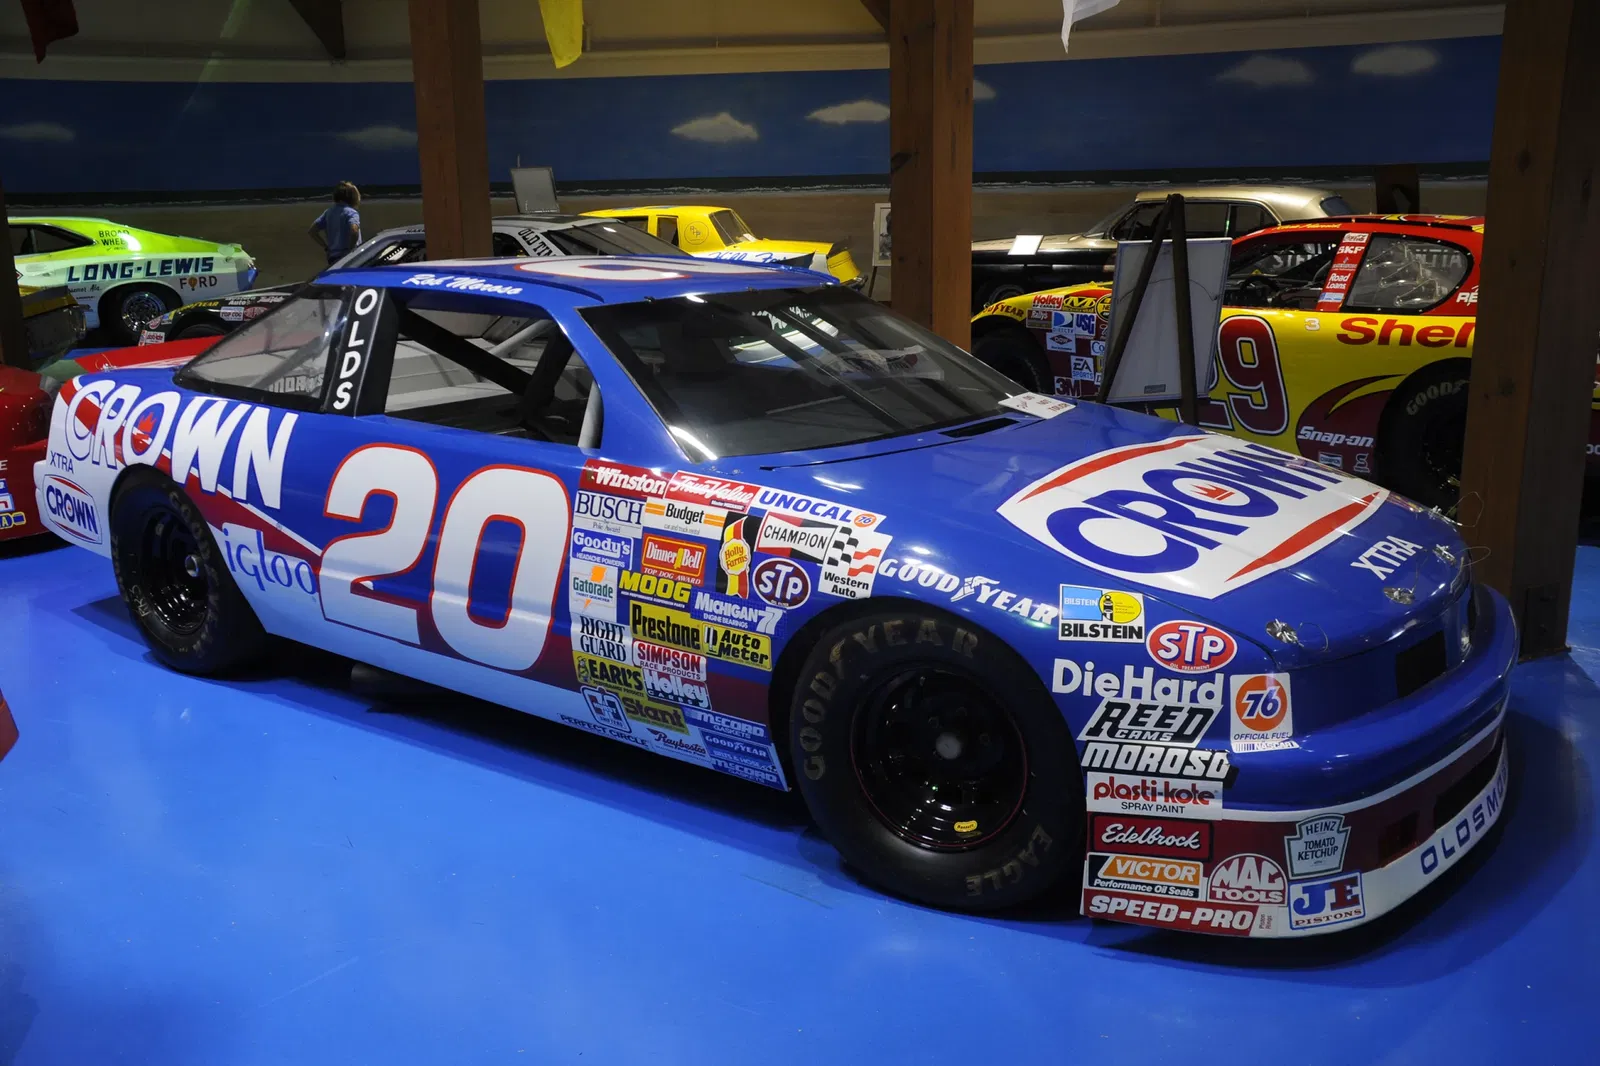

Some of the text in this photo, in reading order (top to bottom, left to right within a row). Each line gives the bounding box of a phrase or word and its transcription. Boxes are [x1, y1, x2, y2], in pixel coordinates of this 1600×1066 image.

[1337, 245, 1365, 255] SKF
[68, 257, 214, 282] LONG-LEWIS
[1328, 272, 1351, 282] Road
[1326, 281, 1347, 290] Loans
[1033, 295, 1063, 309] Holley
[1076, 314, 1095, 334] USG
[1336, 317, 1475, 348] Shel
[333, 288, 378, 410] OLDS
[1072, 371, 1093, 379] SPORTS
[1073, 358, 1092, 372] EA
[1056, 378, 1081, 397] 3M
[65, 379, 299, 510] CROWN
[1297, 426, 1374, 447] Snap-on
[50, 450, 74, 474] XTRA
[596, 466, 667, 495] Winston
[46, 484, 99, 535] CROWN
[575, 492, 645, 526] BUSCH
[666, 503, 704, 525] Budget
[759, 491, 853, 523] UNOCAL
[856, 515, 874, 526] 76
[1046, 444, 1343, 574] CROWN
[573, 532, 631, 556] Goody's
[764, 525, 829, 550] CHAMPION
[223, 528, 317, 595] igloo
[318, 444, 571, 672] 20
[646, 542, 702, 569] Dinner Bell
[724, 545, 744, 562] Holly
[725, 554, 748, 570] Farms
[1350, 535, 1424, 581] XTRA
[573, 576, 614, 599] Gatorade
[618, 570, 692, 603] MOOG
[644, 567, 701, 585] TOP DOG AWARD
[759, 563, 804, 601] STP
[823, 571, 870, 591] Western
[831, 584, 857, 598] Auto
[1064, 597, 1098, 607] BILSTEIN
[580, 615, 625, 643] RIGHT
[632, 603, 701, 651] Prestone
[757, 606, 783, 635] 77
[1061, 623, 1143, 640] BILSTEIN
[580, 635, 626, 662] GUARD
[721, 630, 760, 650] Auto
[1157, 625, 1225, 663] STP
[637, 642, 701, 673] SIMPSON
[719, 643, 769, 665] Meter
[589, 659, 643, 690] EARL'S
[640, 661, 701, 680] RACE PRODUCTS
[1052, 658, 1224, 706] DieHard
[644, 670, 709, 708] Holley
[647, 690, 693, 704] CARBS
[622, 697, 685, 728] Stant
[1241, 686, 1281, 719] 76
[560, 714, 649, 748] PERFECT CIRCLE
[713, 724, 751, 739] GASKETS
[1086, 701, 1214, 743] REED
[1115, 729, 1174, 741] CAMS
[1081, 742, 1231, 779] MOROSO
[1094, 776, 1215, 806] plasti-kote
[1121, 801, 1186, 814] SPRAY PAINT
[1101, 823, 1201, 849] Edelbrock
[1306, 821, 1337, 835] HEINZ
[1297, 846, 1339, 861] KETCHUP
[1304, 837, 1336, 850] TOMATO
[1116, 859, 1198, 882] VICTOR
[1212, 857, 1285, 890] MAC
[1093, 878, 1194, 898] Performance Oil Seals
[1212, 887, 1283, 903] TOOLS
[1293, 876, 1361, 915] JE
[1089, 894, 1254, 931] SPEED-PRO
[1295, 909, 1362, 926] PISTONS
